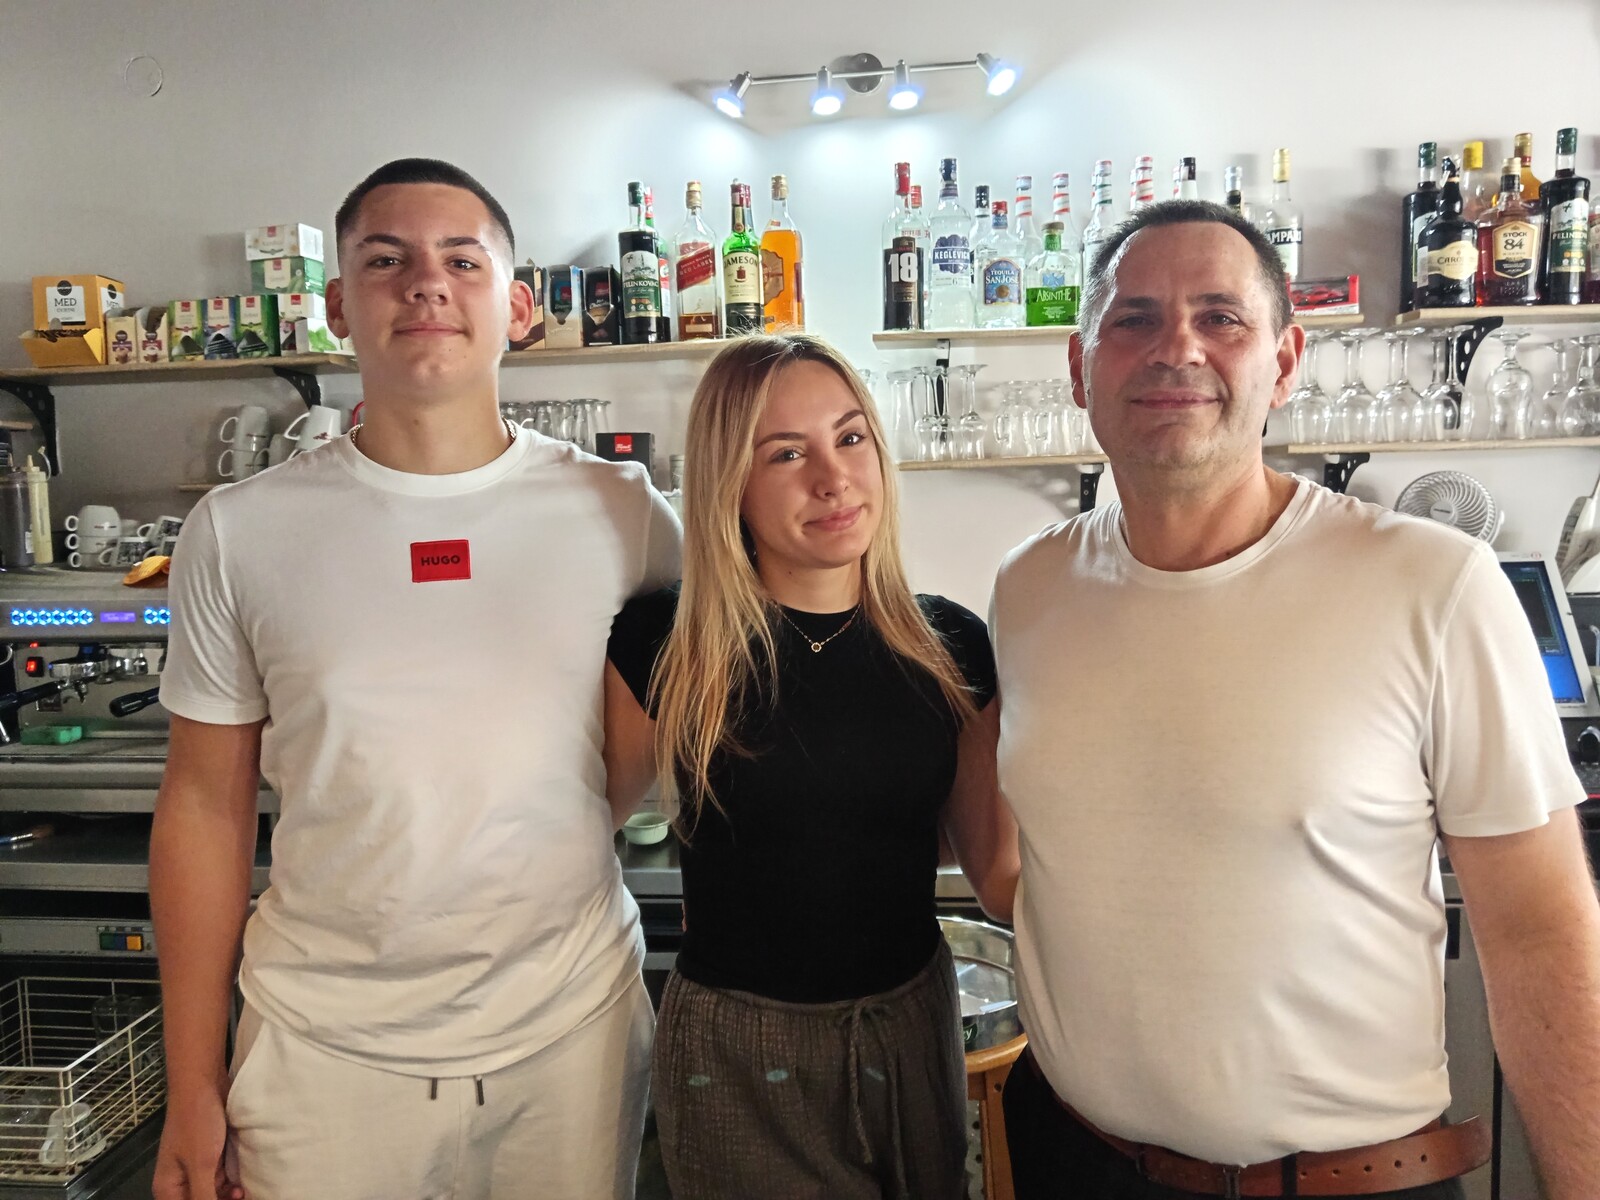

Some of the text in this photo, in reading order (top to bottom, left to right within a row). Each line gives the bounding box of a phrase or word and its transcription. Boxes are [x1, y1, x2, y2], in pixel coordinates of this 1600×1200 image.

[1265, 230, 1302, 245] AMPARI
[1503, 238, 1524, 250] 84
[723, 255, 759, 269] JAMESON
[888, 252, 919, 283] 18
[990, 268, 1015, 276] TEQUILA
[1036, 287, 1072, 302] ABSINTHE
[54, 297, 77, 307] MED
[420, 555, 461, 567] HUGO
